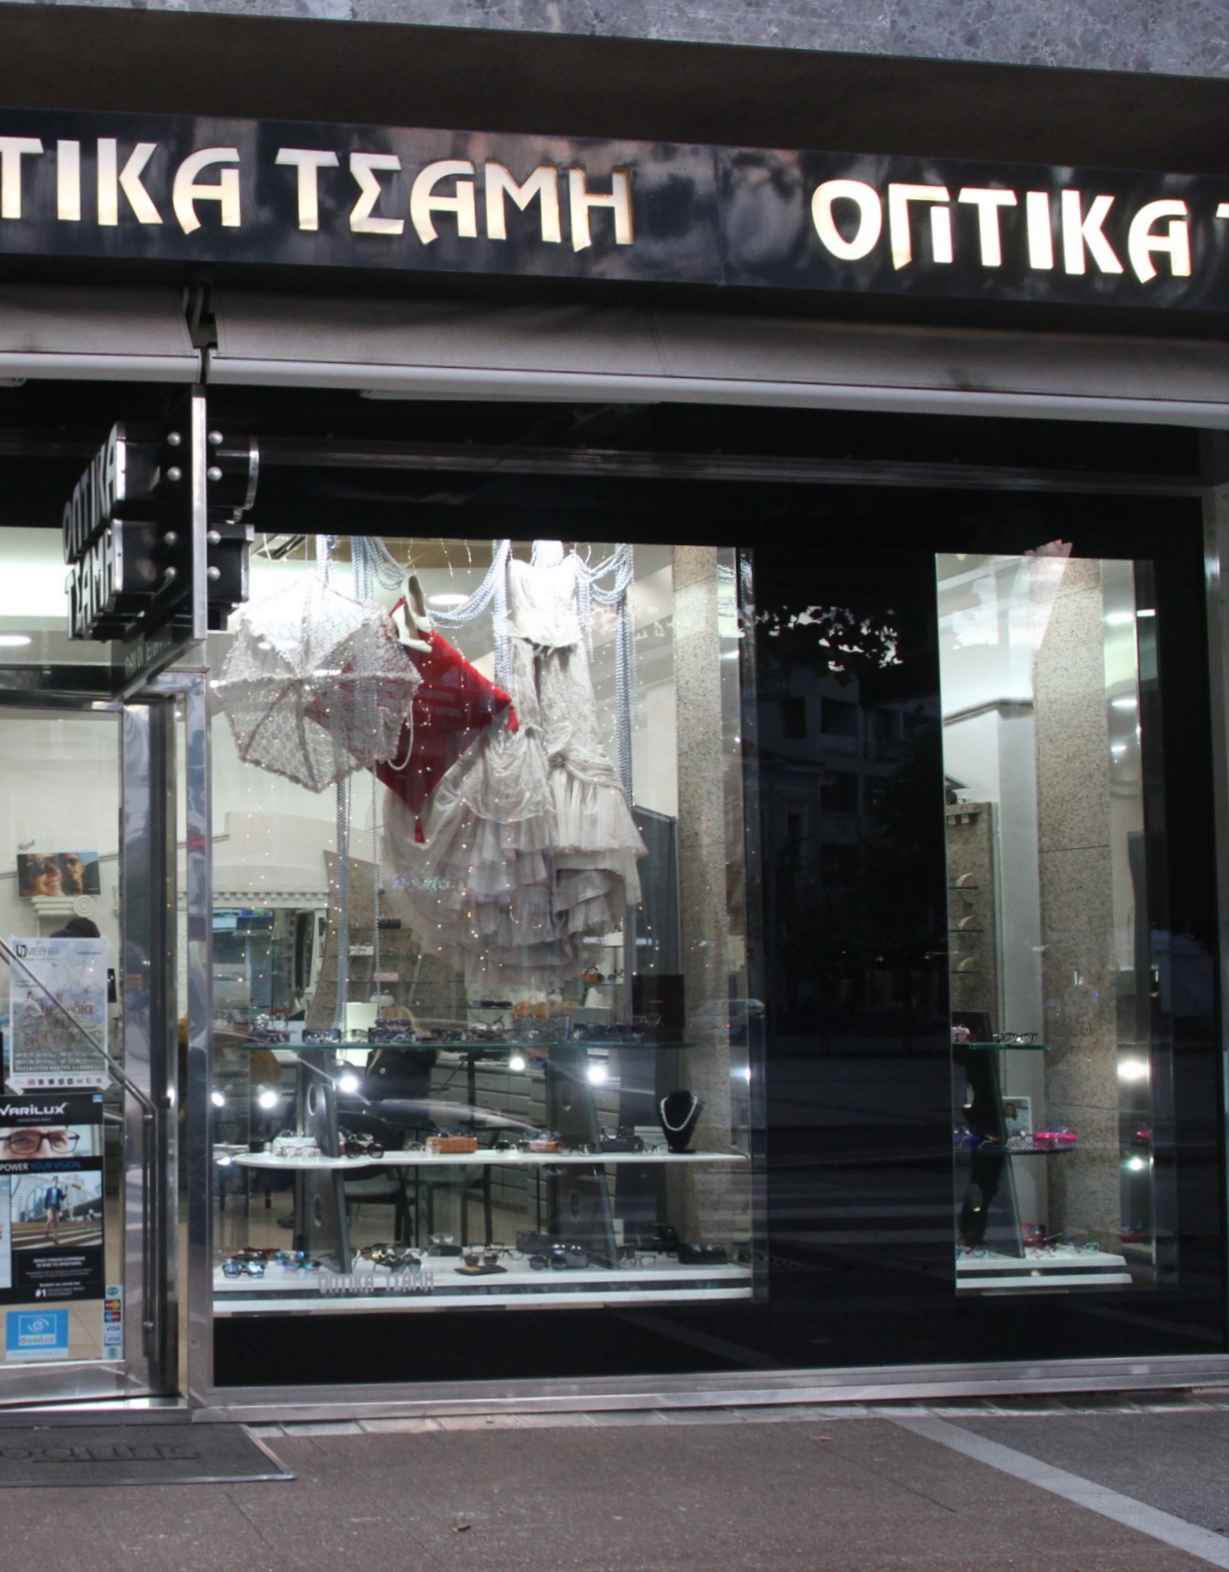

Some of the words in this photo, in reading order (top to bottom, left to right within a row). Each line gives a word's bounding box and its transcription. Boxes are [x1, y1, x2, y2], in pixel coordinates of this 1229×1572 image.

[274, 146, 635, 254] ΤΣΑΜΗ
[811, 179, 1192, 285] ΟΠΤΙΚΑ
[30, 1161, 52, 1171] YOUR
